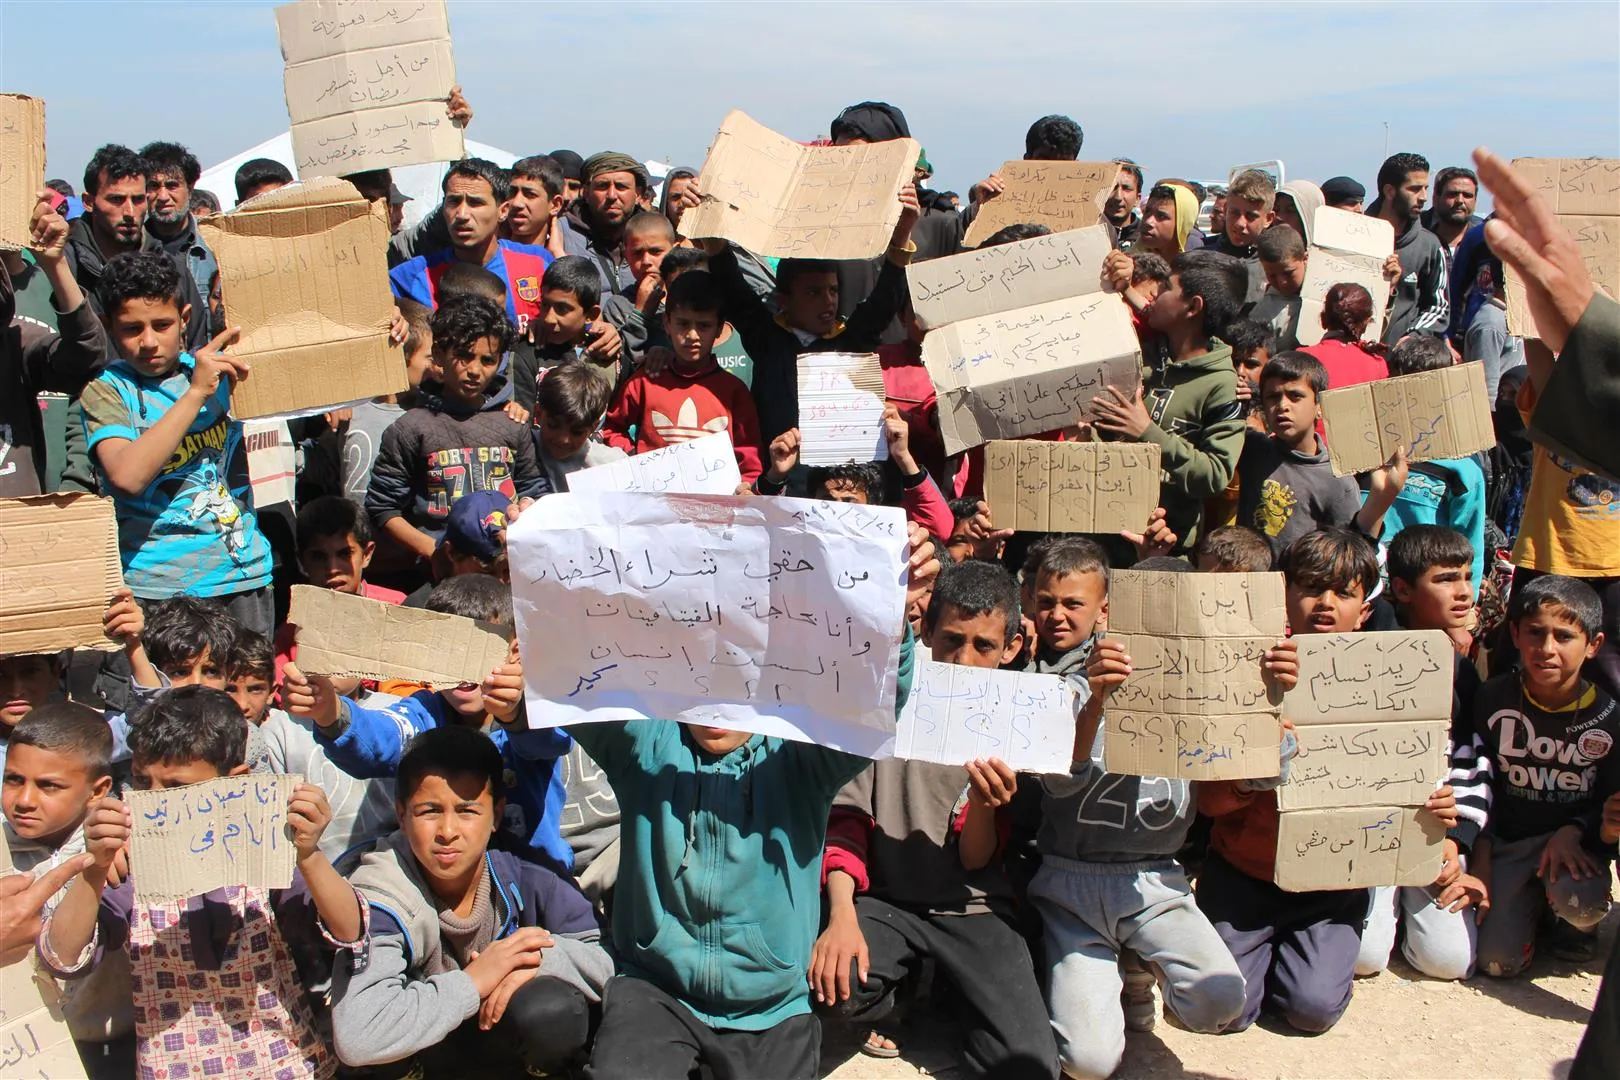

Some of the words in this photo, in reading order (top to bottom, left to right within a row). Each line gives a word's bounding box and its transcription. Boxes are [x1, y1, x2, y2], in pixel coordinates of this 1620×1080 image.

[410, 57, 429, 72] من
[350, 87, 410, 104] رمضان
[1042, 240, 1081, 270] أين
[1080, 301, 1101, 321] كم
[695, 458, 726, 482] هل
[1097, 478, 1133, 497] أين
[530, 547, 623, 586] الخضار
[624, 549, 718, 590] شراء
[743, 549, 815, 583] حقي
[837, 571, 870, 589] من
[740, 595, 818, 627] بحاجة
[1199, 580, 1253, 622] أين
[1309, 657, 1372, 701] تسليم
[1377, 658, 1441, 687] نريد
[1243, 688, 1266, 707] من
[1329, 838, 1355, 853] من
[1363, 827, 1402, 854] هذا
